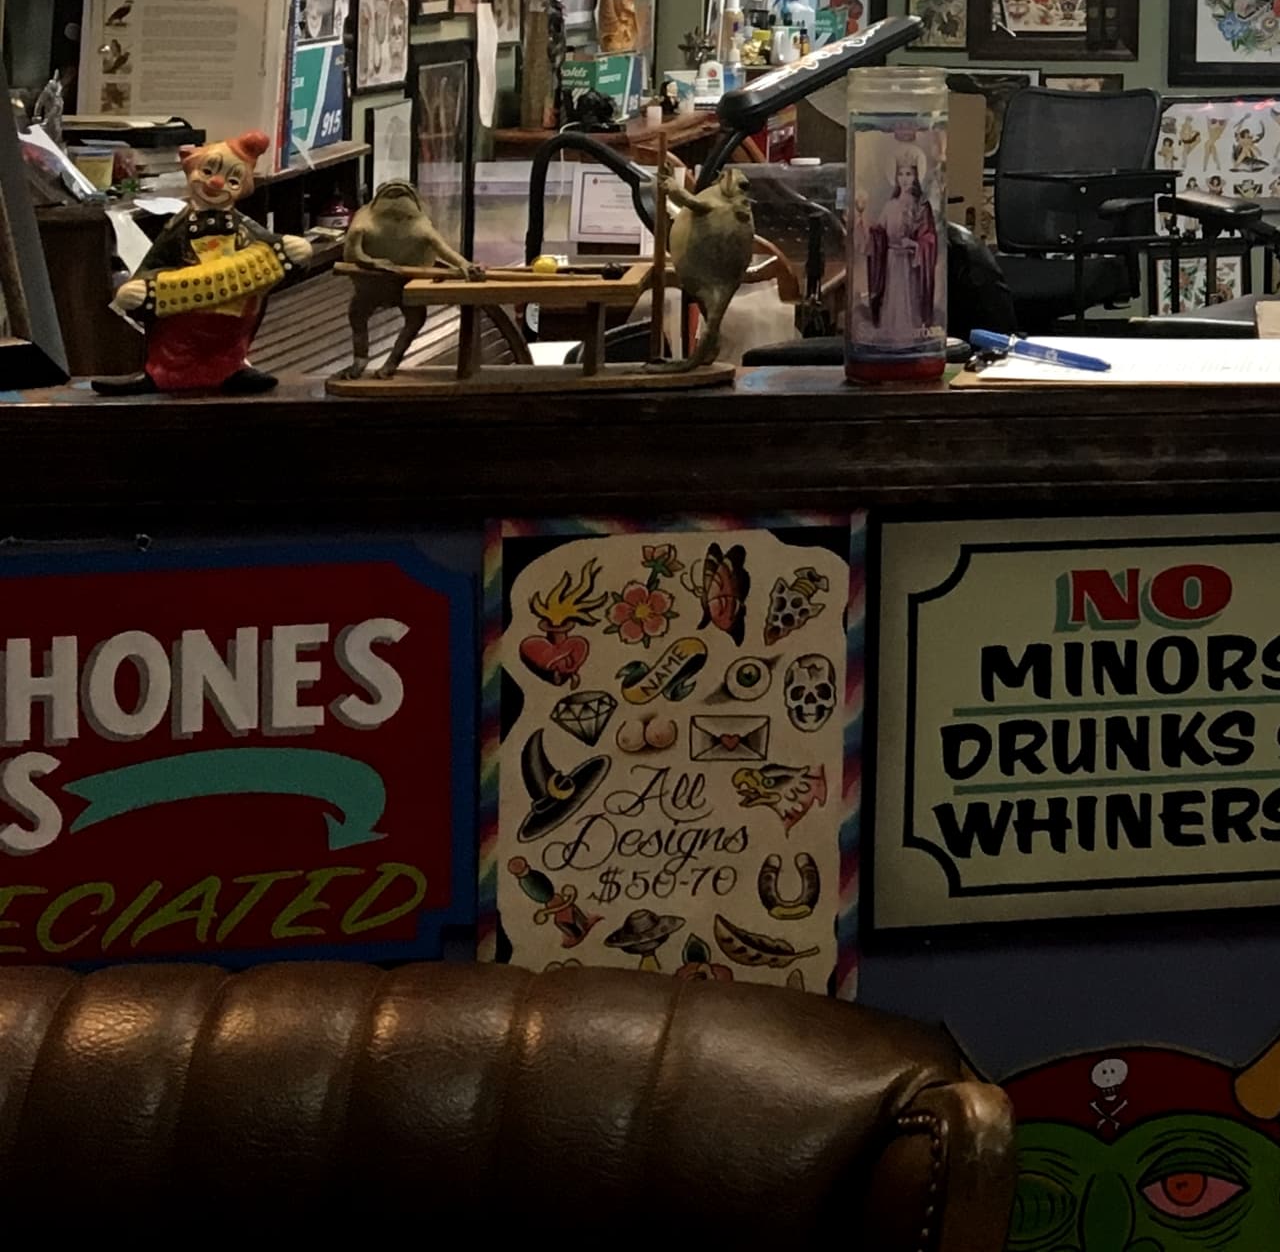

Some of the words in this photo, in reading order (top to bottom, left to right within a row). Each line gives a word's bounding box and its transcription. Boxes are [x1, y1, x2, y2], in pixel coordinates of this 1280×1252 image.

[321, 109, 342, 137] 915
[1054, 563, 1233, 633] NO
[640, 645, 688, 697] NAME
[940, 709, 1256, 781] DRUNKS
[603, 764, 715, 823] All
[542, 812, 749, 875] Designs
[596, 864, 737, 904] $50-70
